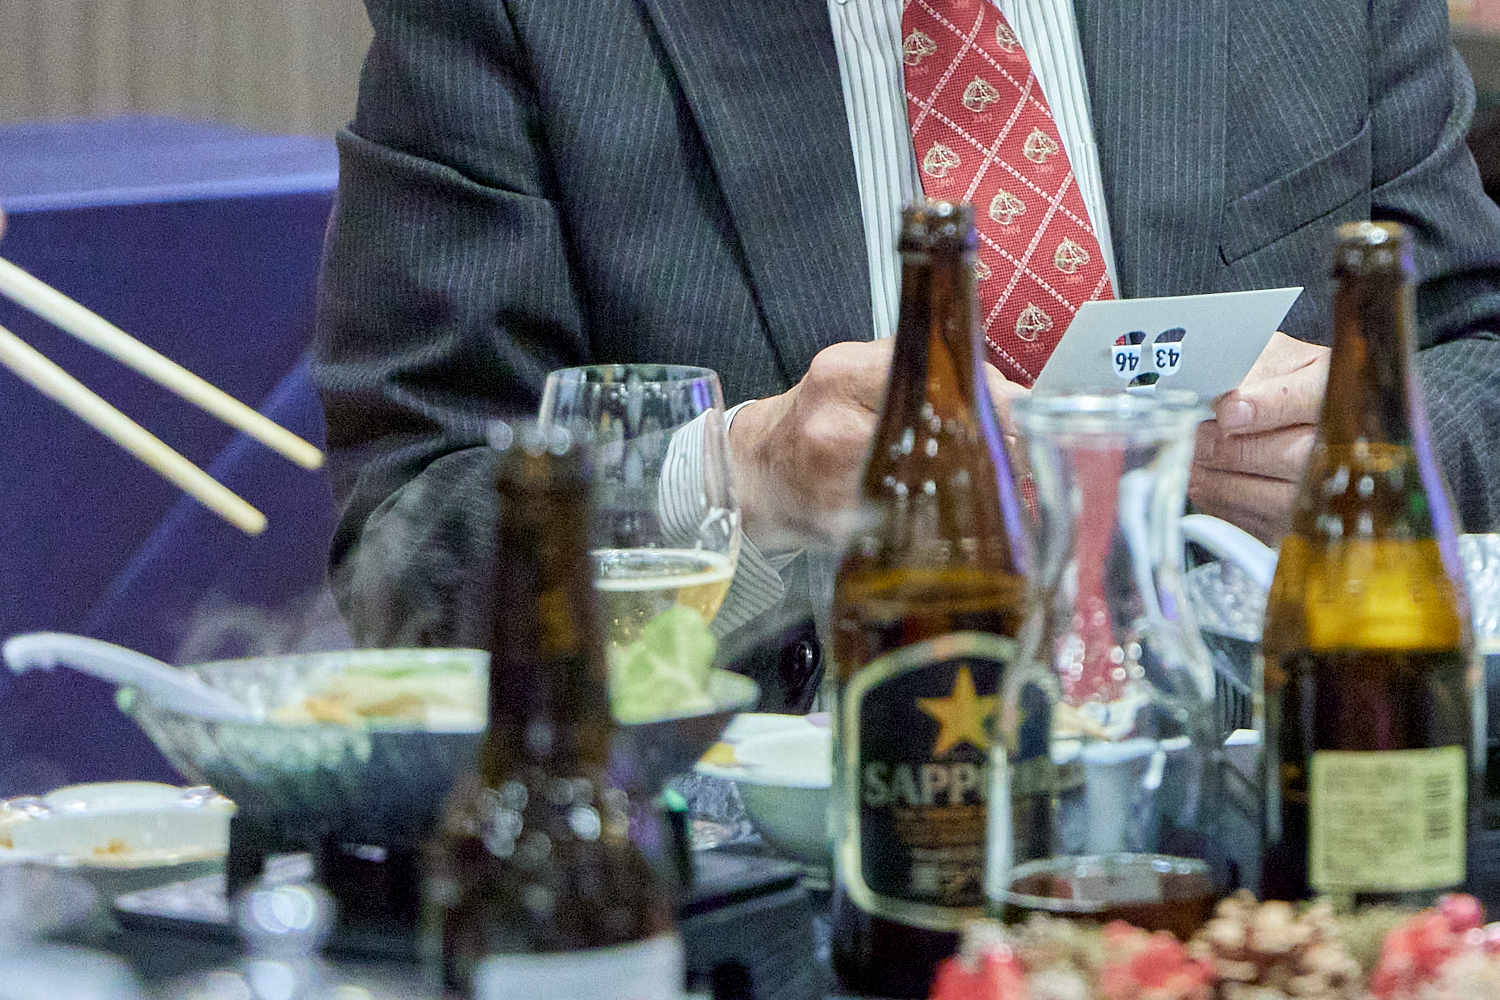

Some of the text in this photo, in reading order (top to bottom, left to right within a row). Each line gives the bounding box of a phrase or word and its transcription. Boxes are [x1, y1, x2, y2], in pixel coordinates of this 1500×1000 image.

[1115, 348, 1180, 371] 43 46
[864, 761, 995, 808] SAPP
